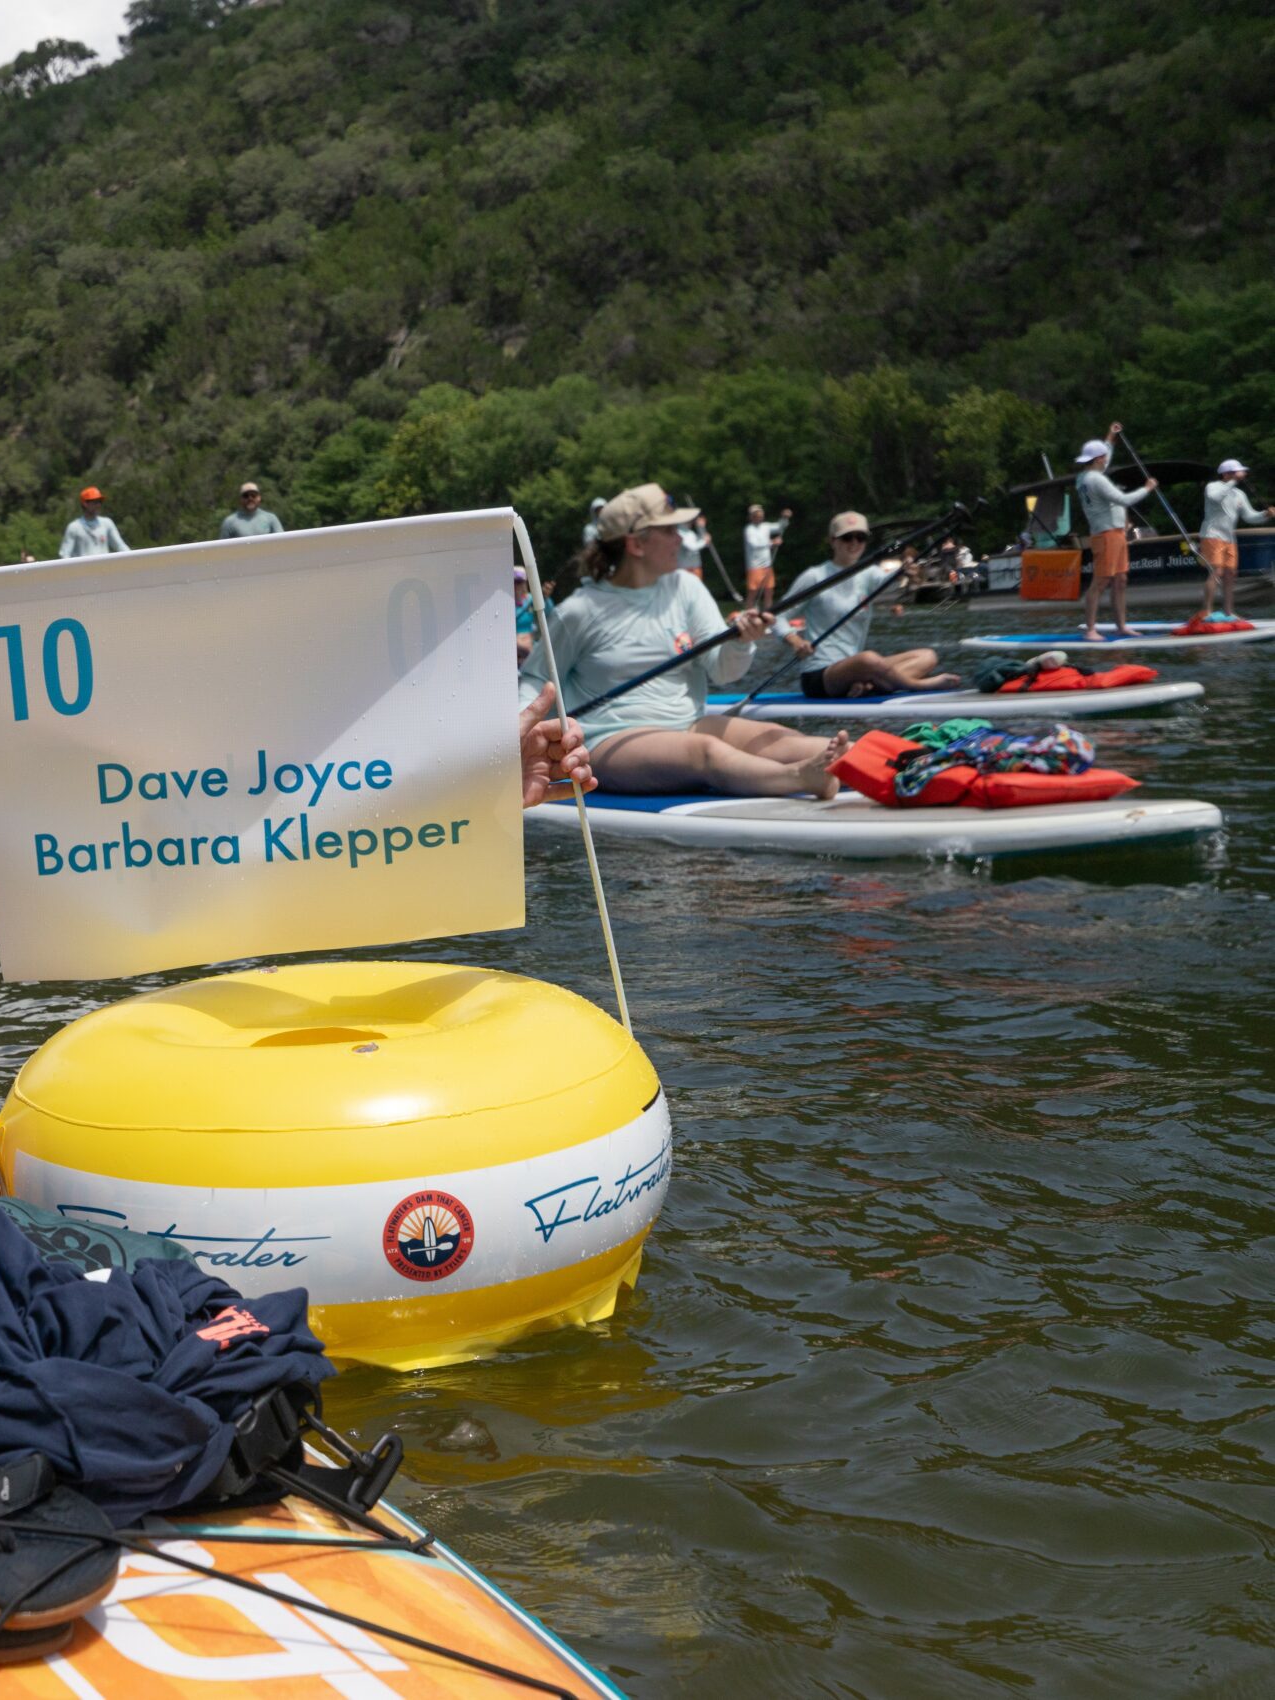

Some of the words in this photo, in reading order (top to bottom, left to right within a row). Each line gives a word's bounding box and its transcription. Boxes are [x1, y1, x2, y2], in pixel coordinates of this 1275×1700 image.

[97, 763, 229, 805] Dave
[247, 749, 393, 807] Joyce
[34, 821, 241, 876] Barbara
[263, 813, 470, 869] Klepper
[415, 1193, 433, 1204] DAM
[436, 1194, 454, 1206] THAT
[453, 1205, 471, 1232] CANCER
[394, 1257, 431, 1278] PRESENTED
[433, 1268, 443, 1278] BY
